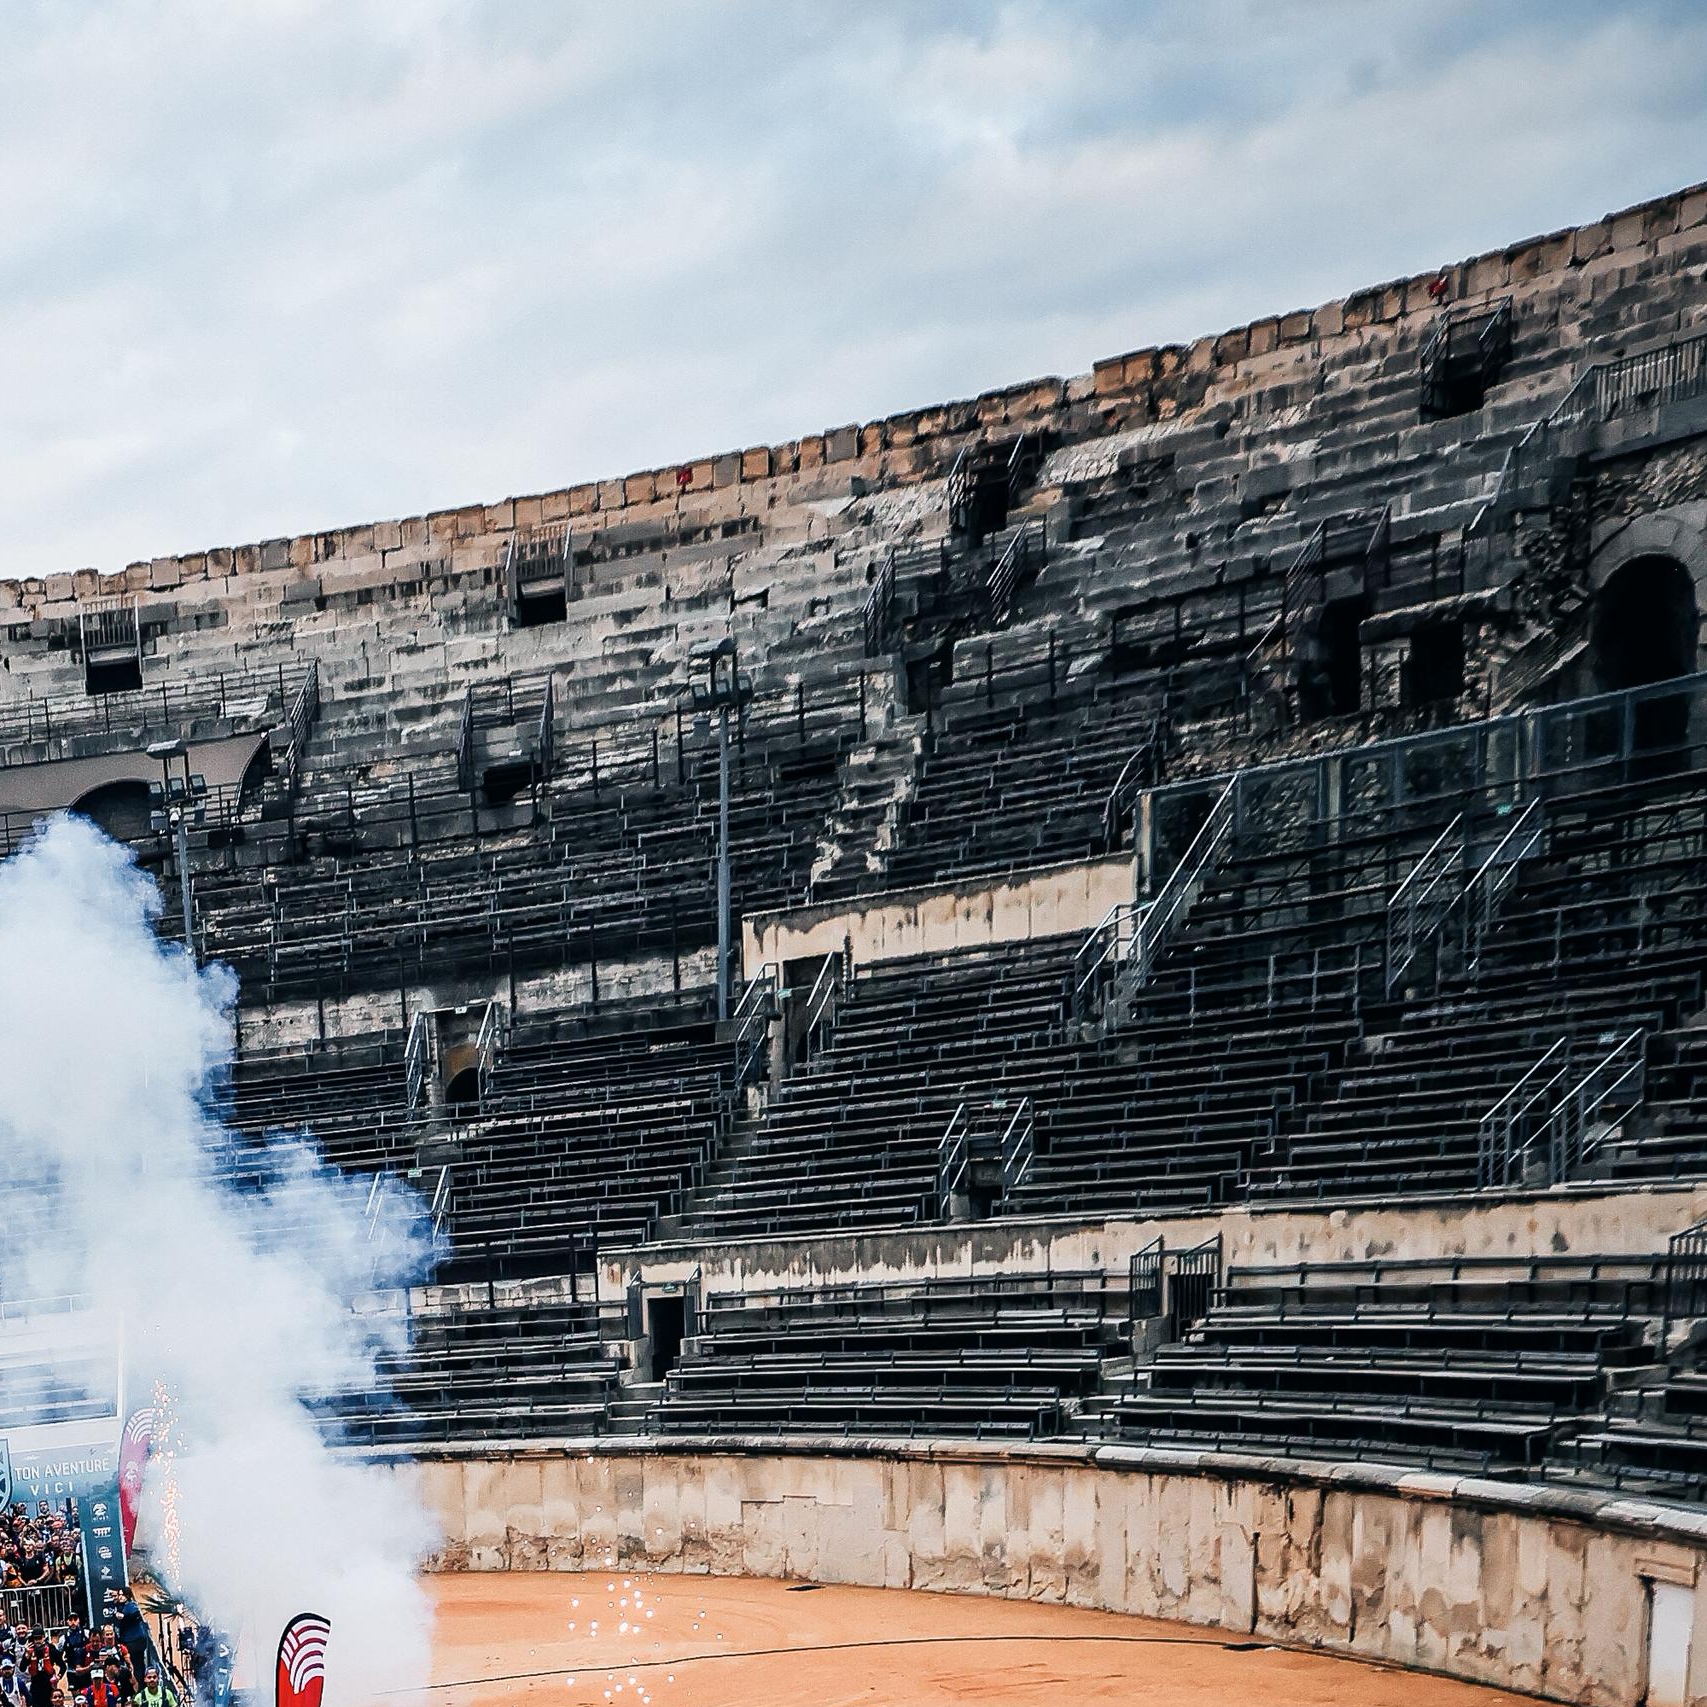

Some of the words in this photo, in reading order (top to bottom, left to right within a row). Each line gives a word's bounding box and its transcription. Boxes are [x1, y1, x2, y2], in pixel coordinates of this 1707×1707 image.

[15, 1466, 40, 1480] TON
[44, 1458, 109, 1478] AVENTURE
[30, 1481, 73, 1496] VICI
